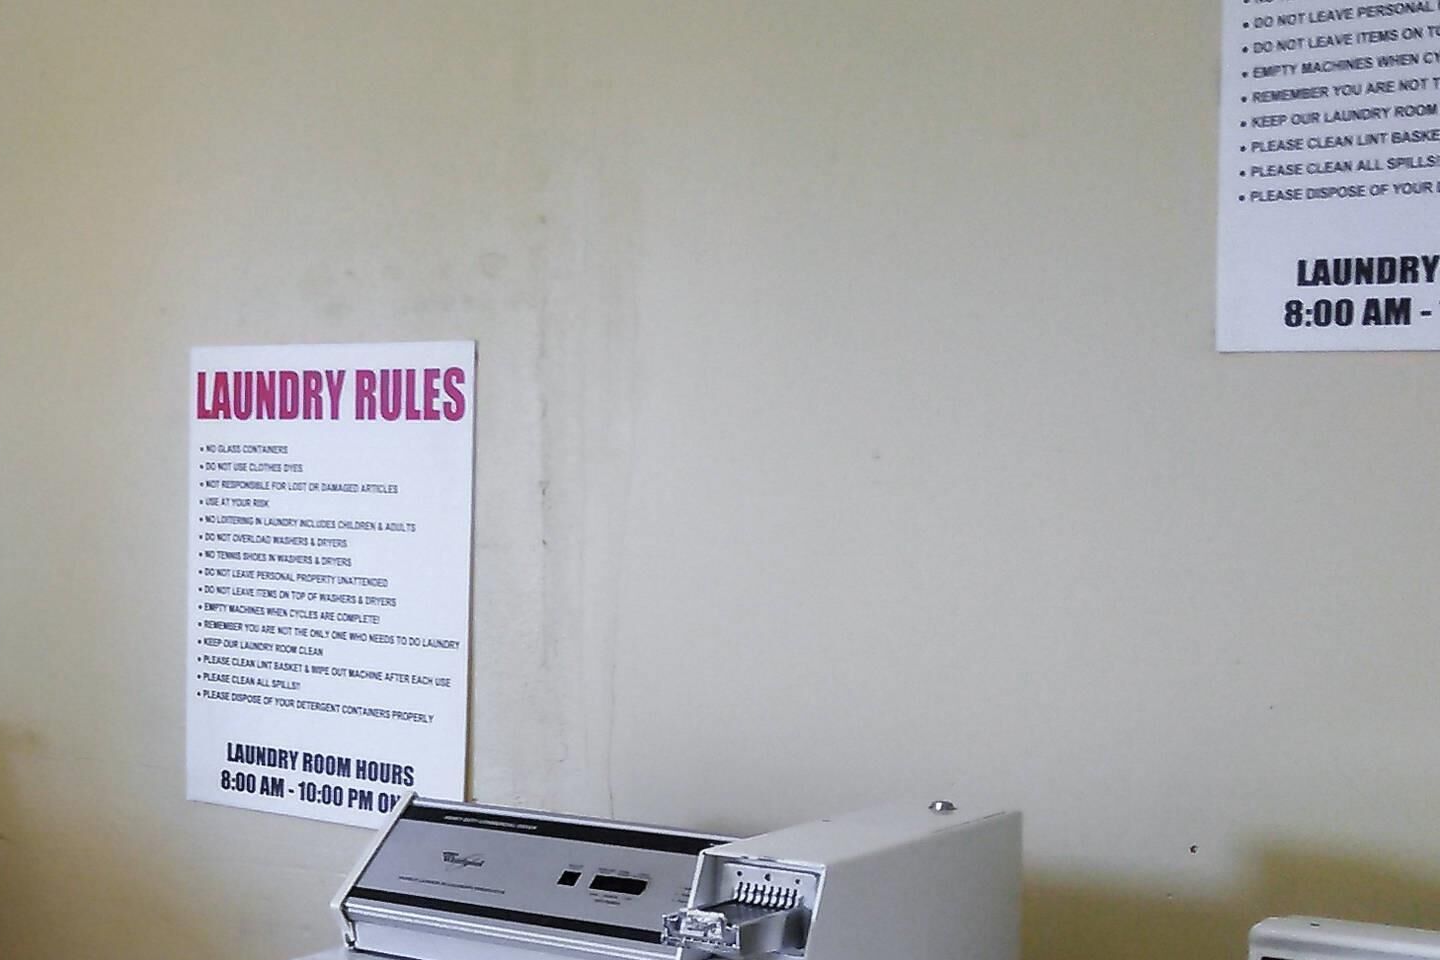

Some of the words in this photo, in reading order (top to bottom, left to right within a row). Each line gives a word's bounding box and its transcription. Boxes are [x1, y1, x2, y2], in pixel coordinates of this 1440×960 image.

[1254, 15, 1273, 28] DO
[1277, 12, 1305, 26] NOT
[1308, 7, 1352, 23] LEAVE
[1357, 2, 1433, 18] PERSONAL
[1253, 40, 1272, 53] DO
[1276, 37, 1304, 51] NOT
[1308, 33, 1351, 48] LEAVE
[1356, 28, 1398, 44] ITEMS
[1401, 26, 1422, 40] ON
[1253, 63, 1296, 78] EMPTY
[1301, 56, 1372, 74] MACHINES
[1377, 52, 1418, 67] WHEN
[1252, 86, 1328, 103] REMEMBER
[1332, 83, 1361, 96] YOU
[1365, 80, 1394, 94] ARE
[1398, 77, 1428, 92] NOT
[1252, 114, 1286, 128] KEEP
[1290, 111, 1320, 125] OUR
[1324, 106, 1390, 122] LAUNDRY
[1394, 103, 1437, 118] ROOM
[1251, 138, 1303, 152] PLEASE
[1307, 134, 1352, 149] CLEAN
[1356, 132, 1388, 146] LINT
[1250, 163, 1302, 177] PLEASE
[1306, 160, 1351, 174] CLEAN
[1356, 158, 1383, 171] ALL
[1250, 188, 1302, 202] PLEASE
[1306, 185, 1365, 199] DISPOSE
[1369, 183, 1388, 196] OF
[1392, 181, 1433, 194] YOUR
[1297, 255, 1440, 286] LAUNDRY
[1284, 299, 1354, 327] 8:00
[1362, 298, 1412, 326] AM
[196, 368, 346, 421] LAUNDRY
[354, 366, 466, 422] RULES
[206, 444, 215, 452] NO
[217, 444, 240, 453] GLASS
[205, 462, 215, 470] DO
[217, 462, 231, 470] NOT
[233, 462, 246, 471] USE
[249, 462, 281, 471] CLOTHES
[283, 463, 302, 472] DYES
[205, 479, 219, 487] NOT
[271, 481, 285, 490] FOR
[288, 481, 306, 490] LOST
[308, 482, 318, 491] OR
[321, 482, 358, 492] DAMAGED
[205, 497, 218, 505] USE
[220, 497, 229, 505] AT
[231, 498, 250, 506] YOUR
[205, 514, 215, 523] NO
[264, 517, 297, 526] LAUNDRY
[338, 520, 375, 530] CHILDREN
[205, 532, 214, 541] DO
[216, 532, 231, 541] NOT
[232, 533, 270, 543] OVERLOAD
[272, 536, 307, 545] WASHERS
[317, 538, 346, 547] DRYERS
[204, 550, 214, 558] NO
[242, 552, 266, 561] SHOES
[277, 554, 312, 564] WASHERS
[321, 556, 351, 566] DRYERS
[204, 567, 215, 576] DO
[215, 568, 230, 576] NOT
[232, 569, 254, 578] LEAVE
[256, 570, 294, 581] PERSONAL
[296, 573, 335, 583] PROPERTY
[204, 584, 214, 593] DO
[216, 586, 230, 594] NOT
[232, 586, 254, 596] LEAVE
[279, 590, 288, 598] ON
[291, 590, 305, 600] TOP
[307, 592, 317, 600] OF
[319, 592, 356, 603] WASHERS
[365, 596, 396, 606] DRYERS
[204, 602, 227, 612] EMPTY
[228, 604, 264, 615] MACHINES
[266, 607, 287, 616] WHEN
[290, 608, 317, 619] CYCLES
[320, 611, 334, 620] ARE
[204, 619, 242, 631] REMEMBER
[244, 623, 258, 632] YOU
[261, 624, 274, 634] ARE
[277, 625, 292, 635] NOT
[294, 627, 307, 636] THE
[310, 629, 328, 638] ONLY
[331, 630, 346, 640] ONE
[349, 632, 366, 641] WHO
[369, 633, 394, 644] NEEDS
[396, 635, 406, 645] TO
[409, 636, 420, 646] DO
[422, 638, 459, 649] LAUNDRY
[203, 637, 222, 646] KEEP
[223, 639, 238, 648] OUR
[240, 640, 272, 651] LAUNDRY
[275, 644, 296, 653] ROOM
[299, 646, 322, 656] CLEAN
[203, 654, 230, 665] PLEASE
[232, 657, 254, 667] CLEAN
[256, 660, 272, 669] LINT
[274, 661, 302, 672] BASKET
[331, 667, 346, 676] OUT
[348, 668, 382, 680] MACHINE
[384, 672, 408, 683] AFTER
[411, 674, 432, 685] EACH
[435, 677, 450, 687] USE
[203, 672, 229, 683] PLEASE
[232, 675, 254, 685] CLEAN
[256, 678, 269, 687] ALL
[202, 689, 229, 700] PLEASE
[231, 692, 260, 703] DISPOSE
[263, 696, 272, 705] OF
[274, 697, 294, 707] YOUR
[296, 699, 340, 712] DETERGENT
[392, 710, 433, 723] PROPERLY
[227, 742, 300, 770] LAUNDRY
[302, 752, 351, 778] ROOM
[356, 759, 414, 787] HOURS
[221, 770, 256, 793] 8:00
[259, 776, 285, 798] AM
[298, 781, 344, 806] 10:00
[348, 788, 373, 811] PM
[378, 793, 401, 813] ON
